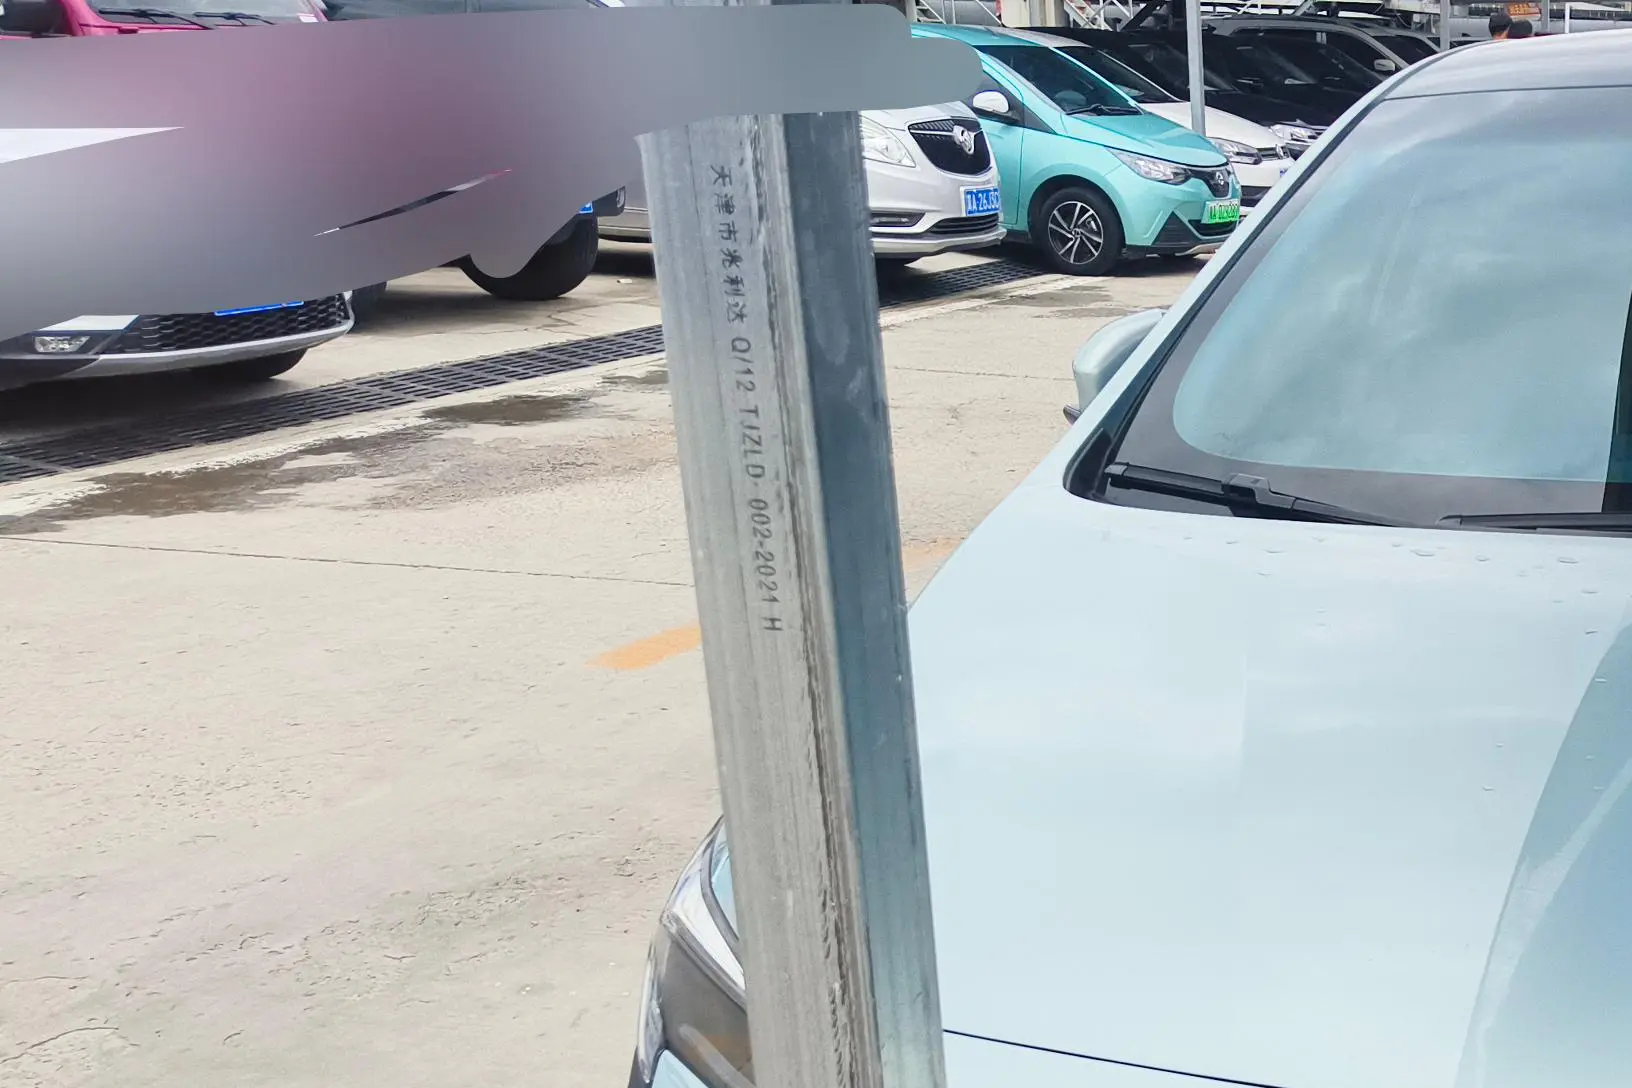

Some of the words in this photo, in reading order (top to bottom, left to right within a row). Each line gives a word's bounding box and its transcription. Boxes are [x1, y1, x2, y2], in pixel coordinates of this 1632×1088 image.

[711, 164, 748, 324] 天津市兆利达
[731, 336, 757, 393] Q/12
[748, 498, 781, 604] 002-2021
[762, 616, 785, 632] H
